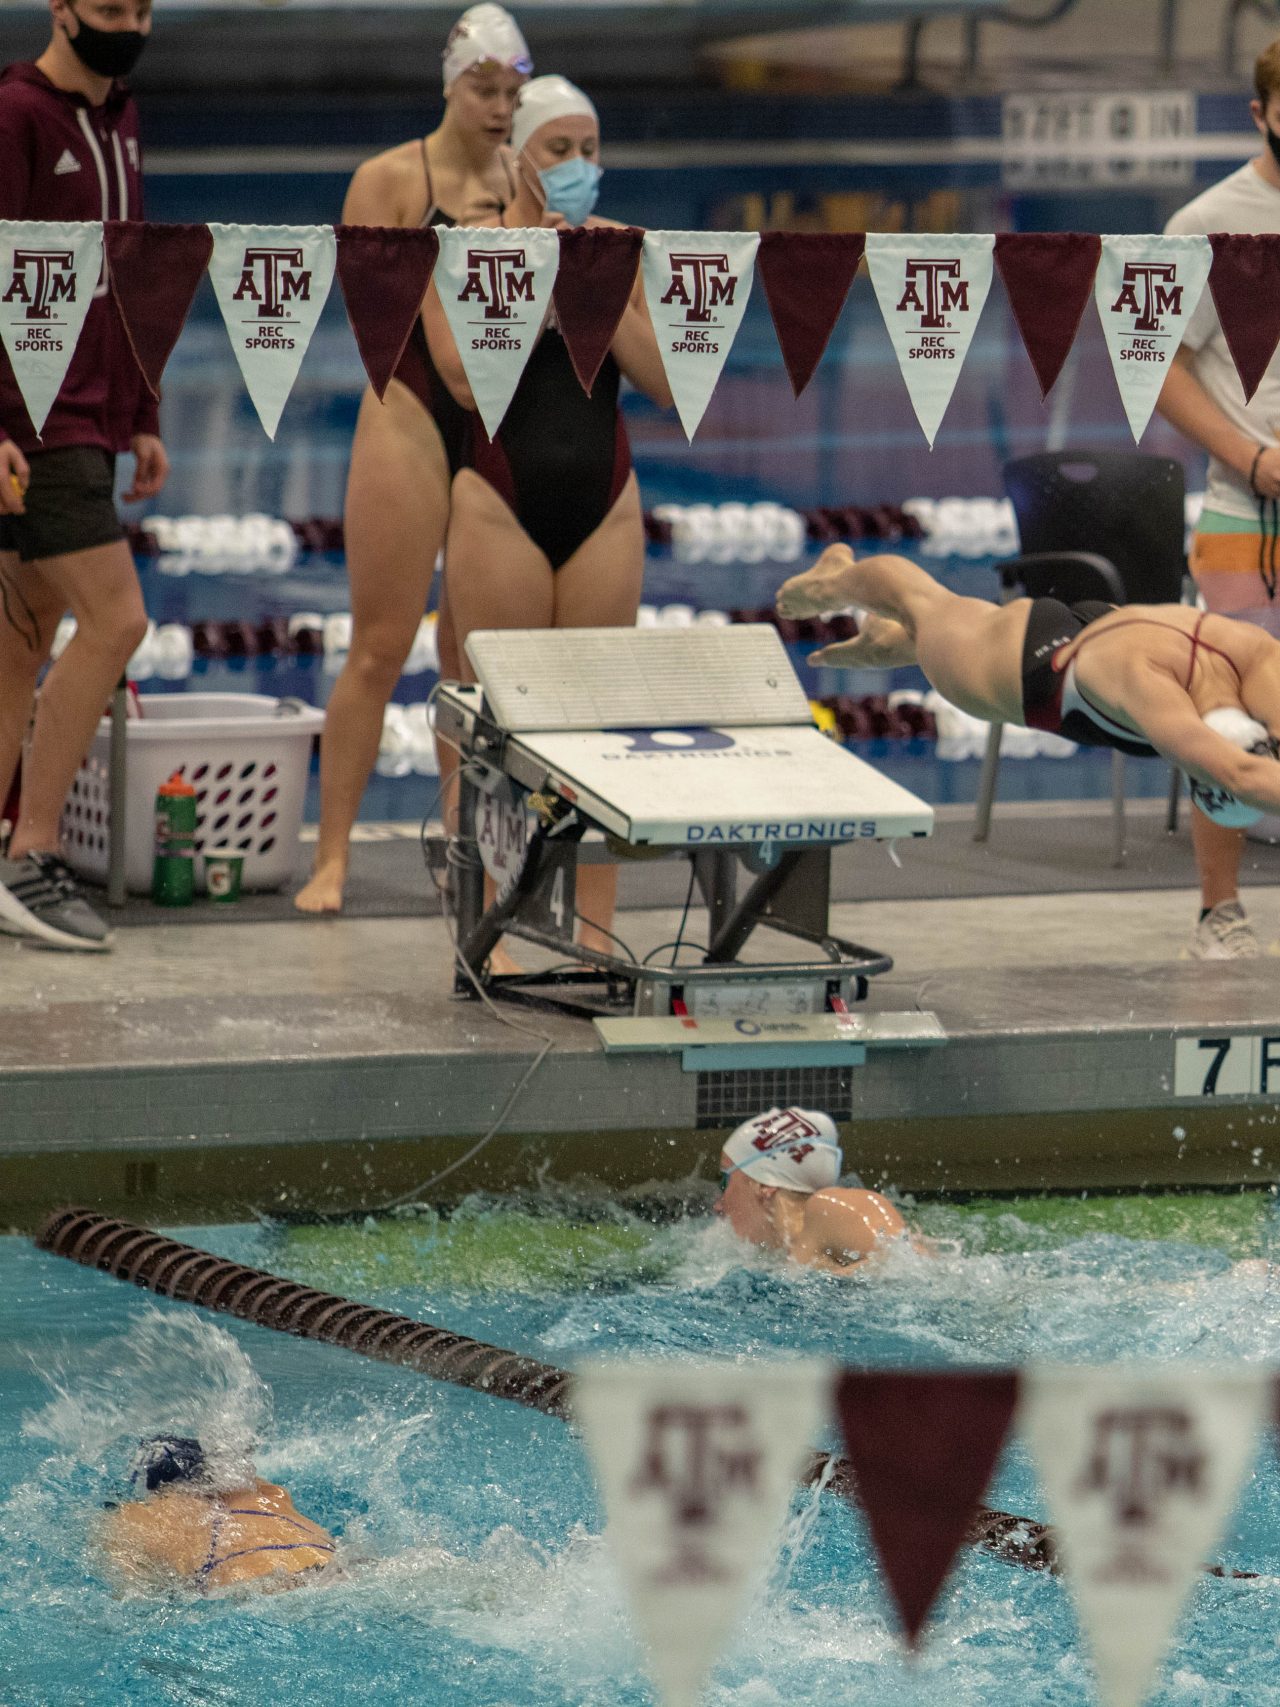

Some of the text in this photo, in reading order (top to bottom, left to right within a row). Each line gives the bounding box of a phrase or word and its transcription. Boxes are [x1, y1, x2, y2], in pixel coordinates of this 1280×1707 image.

[27, 328, 52, 339] REC
[258, 326, 283, 337] REC
[485, 328, 510, 339] REC
[685, 331, 709, 342] REC
[15, 340, 63, 352] SPORTS
[245, 338, 296, 350] SPORTS
[471, 339, 522, 351] SPORTS
[920, 335, 946, 347] REC
[1132, 337, 1157, 349] REC
[672, 342, 719, 354] SPORTS
[909, 346, 956, 360] SPORTS
[1120, 349, 1166, 362] SPORTS
[687, 821, 878, 842] DAKTRONICS
[550, 865, 565, 928] 4
[1198, 1037, 1231, 1096] 7
